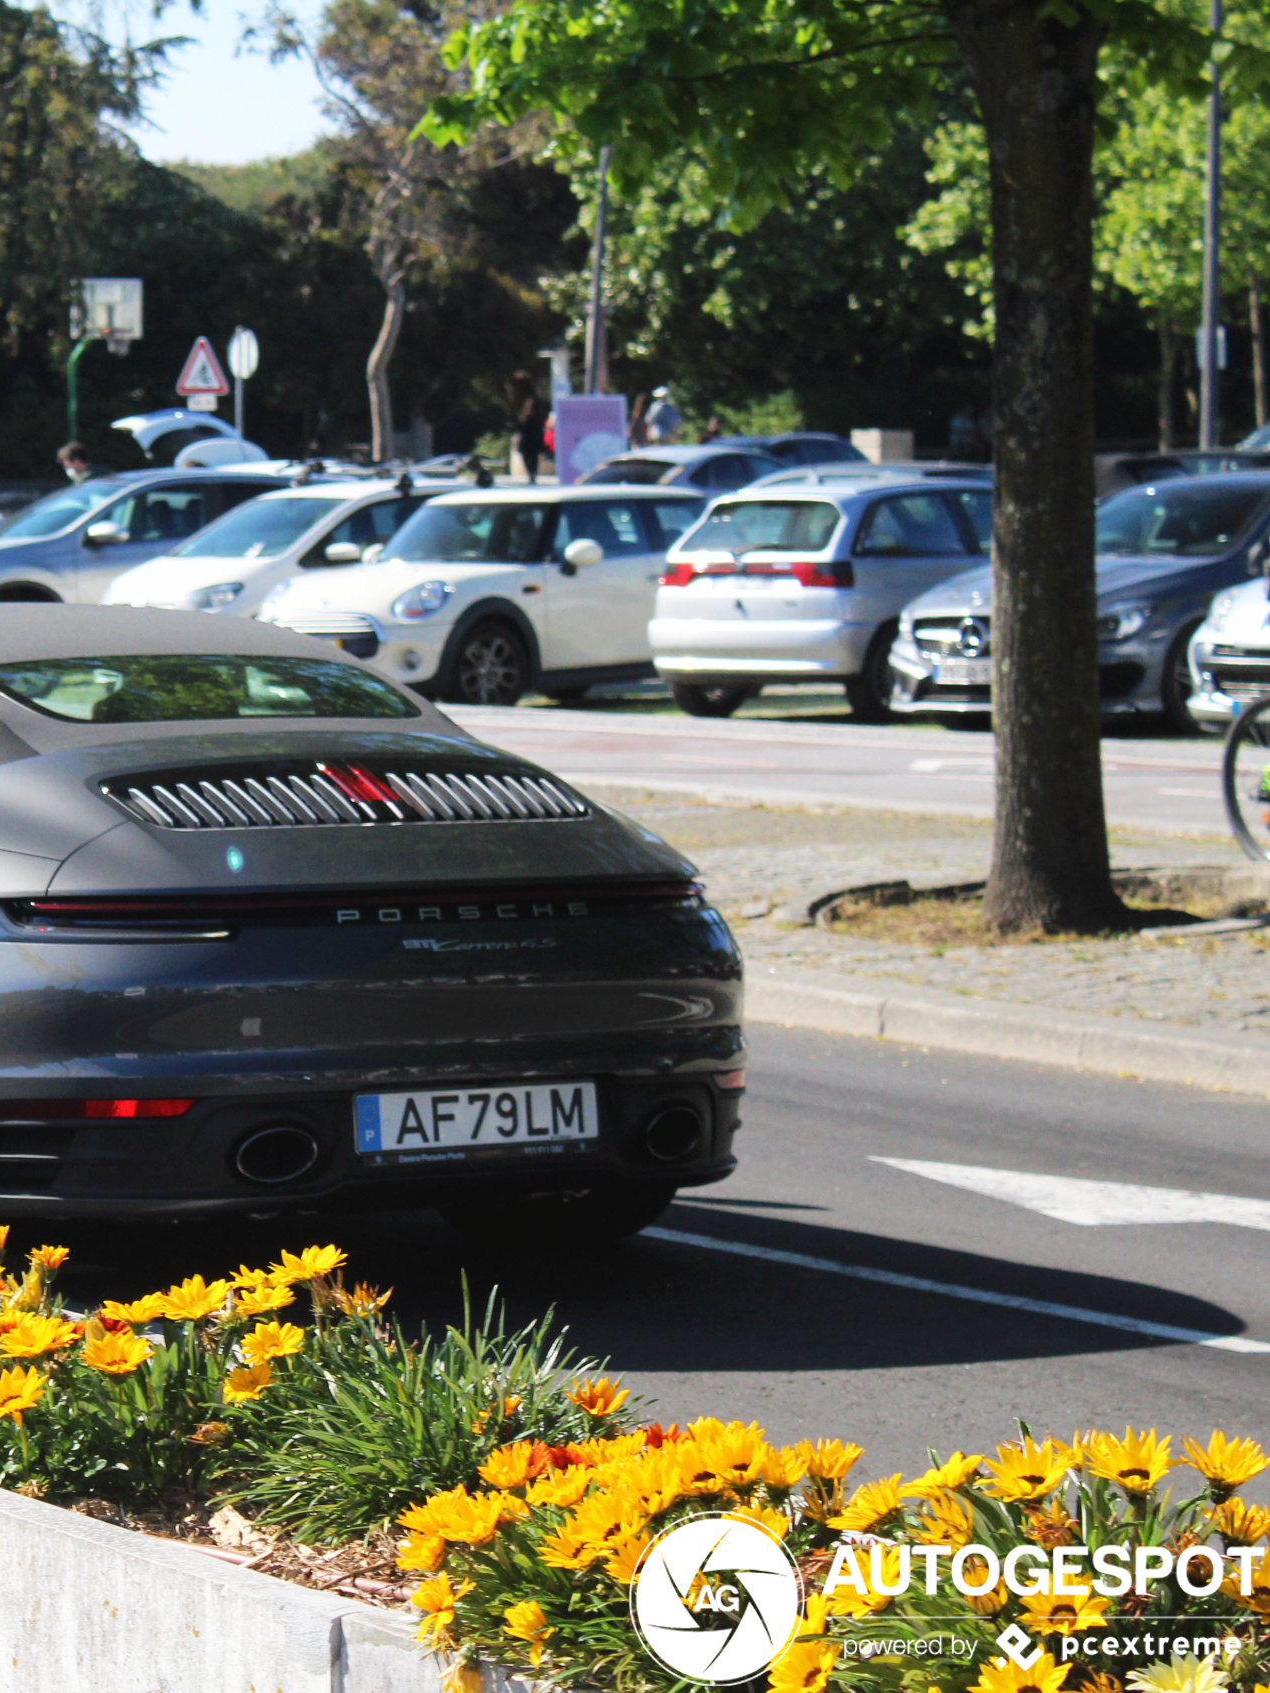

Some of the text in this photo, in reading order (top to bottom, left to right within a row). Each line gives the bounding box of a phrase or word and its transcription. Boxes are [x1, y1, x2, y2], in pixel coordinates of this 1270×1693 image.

[336, 902, 589, 923] PORSCHE
[365, 1087, 585, 1145] P AF79LM
